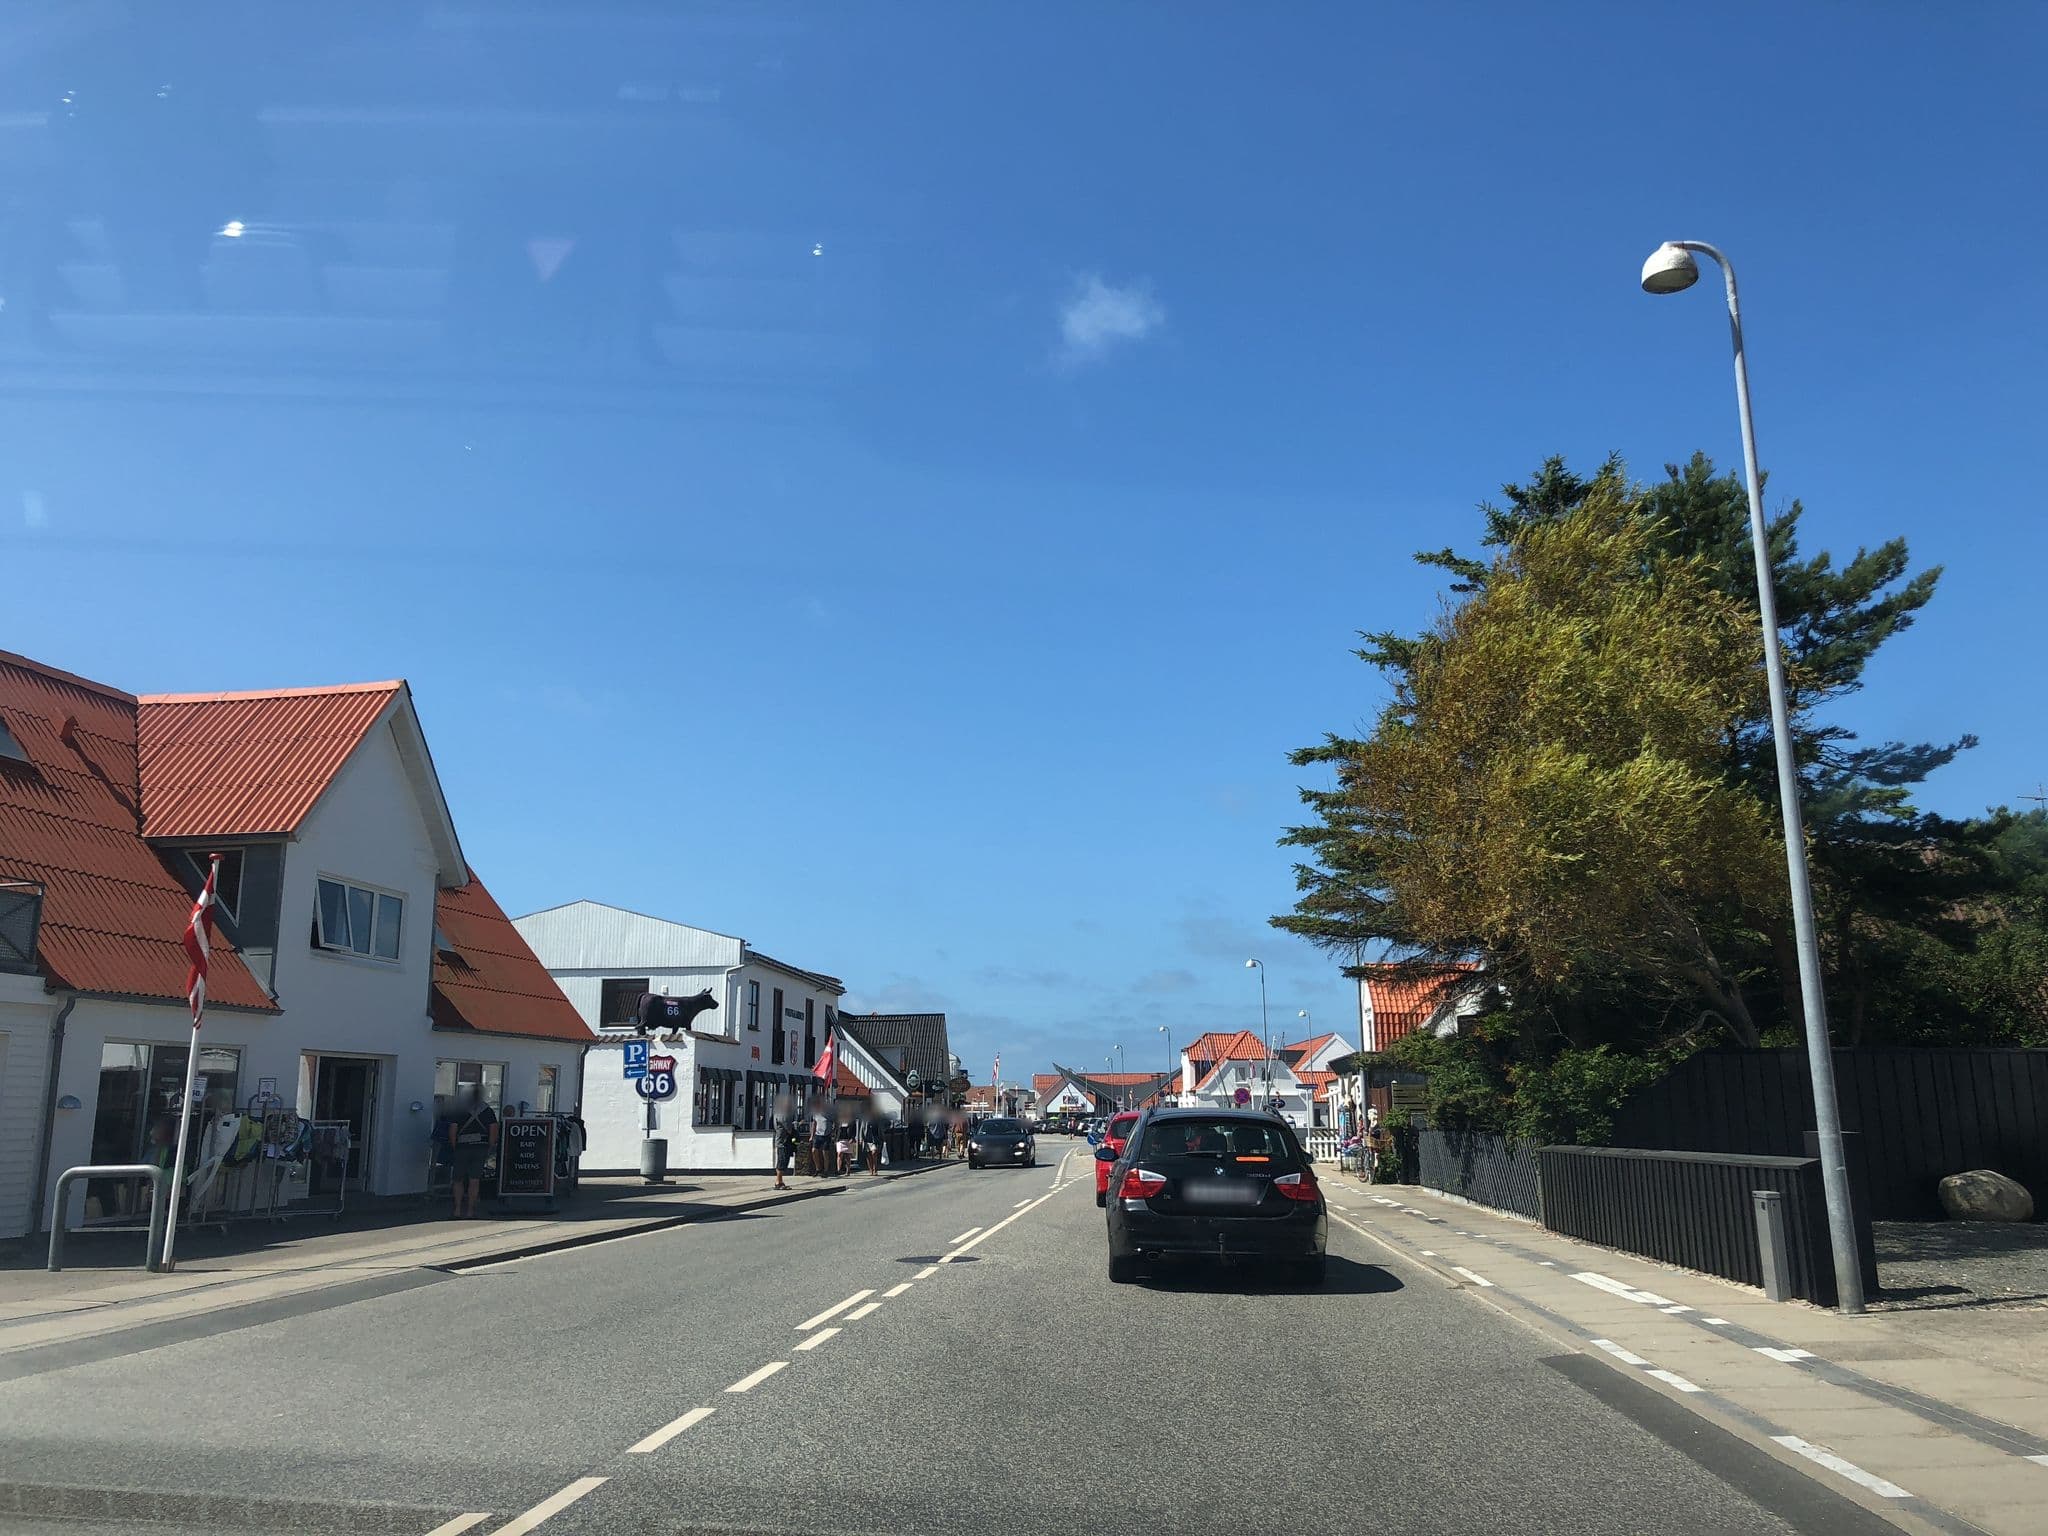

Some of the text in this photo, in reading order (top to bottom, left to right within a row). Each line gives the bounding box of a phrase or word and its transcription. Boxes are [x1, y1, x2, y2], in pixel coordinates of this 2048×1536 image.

[667, 1006, 680, 1016] 66
[628, 1044, 643, 1062] P
[649, 1059, 672, 1070] GHWAY
[641, 1073, 669, 1094] 66
[510, 1125, 547, 1137] OPEN
